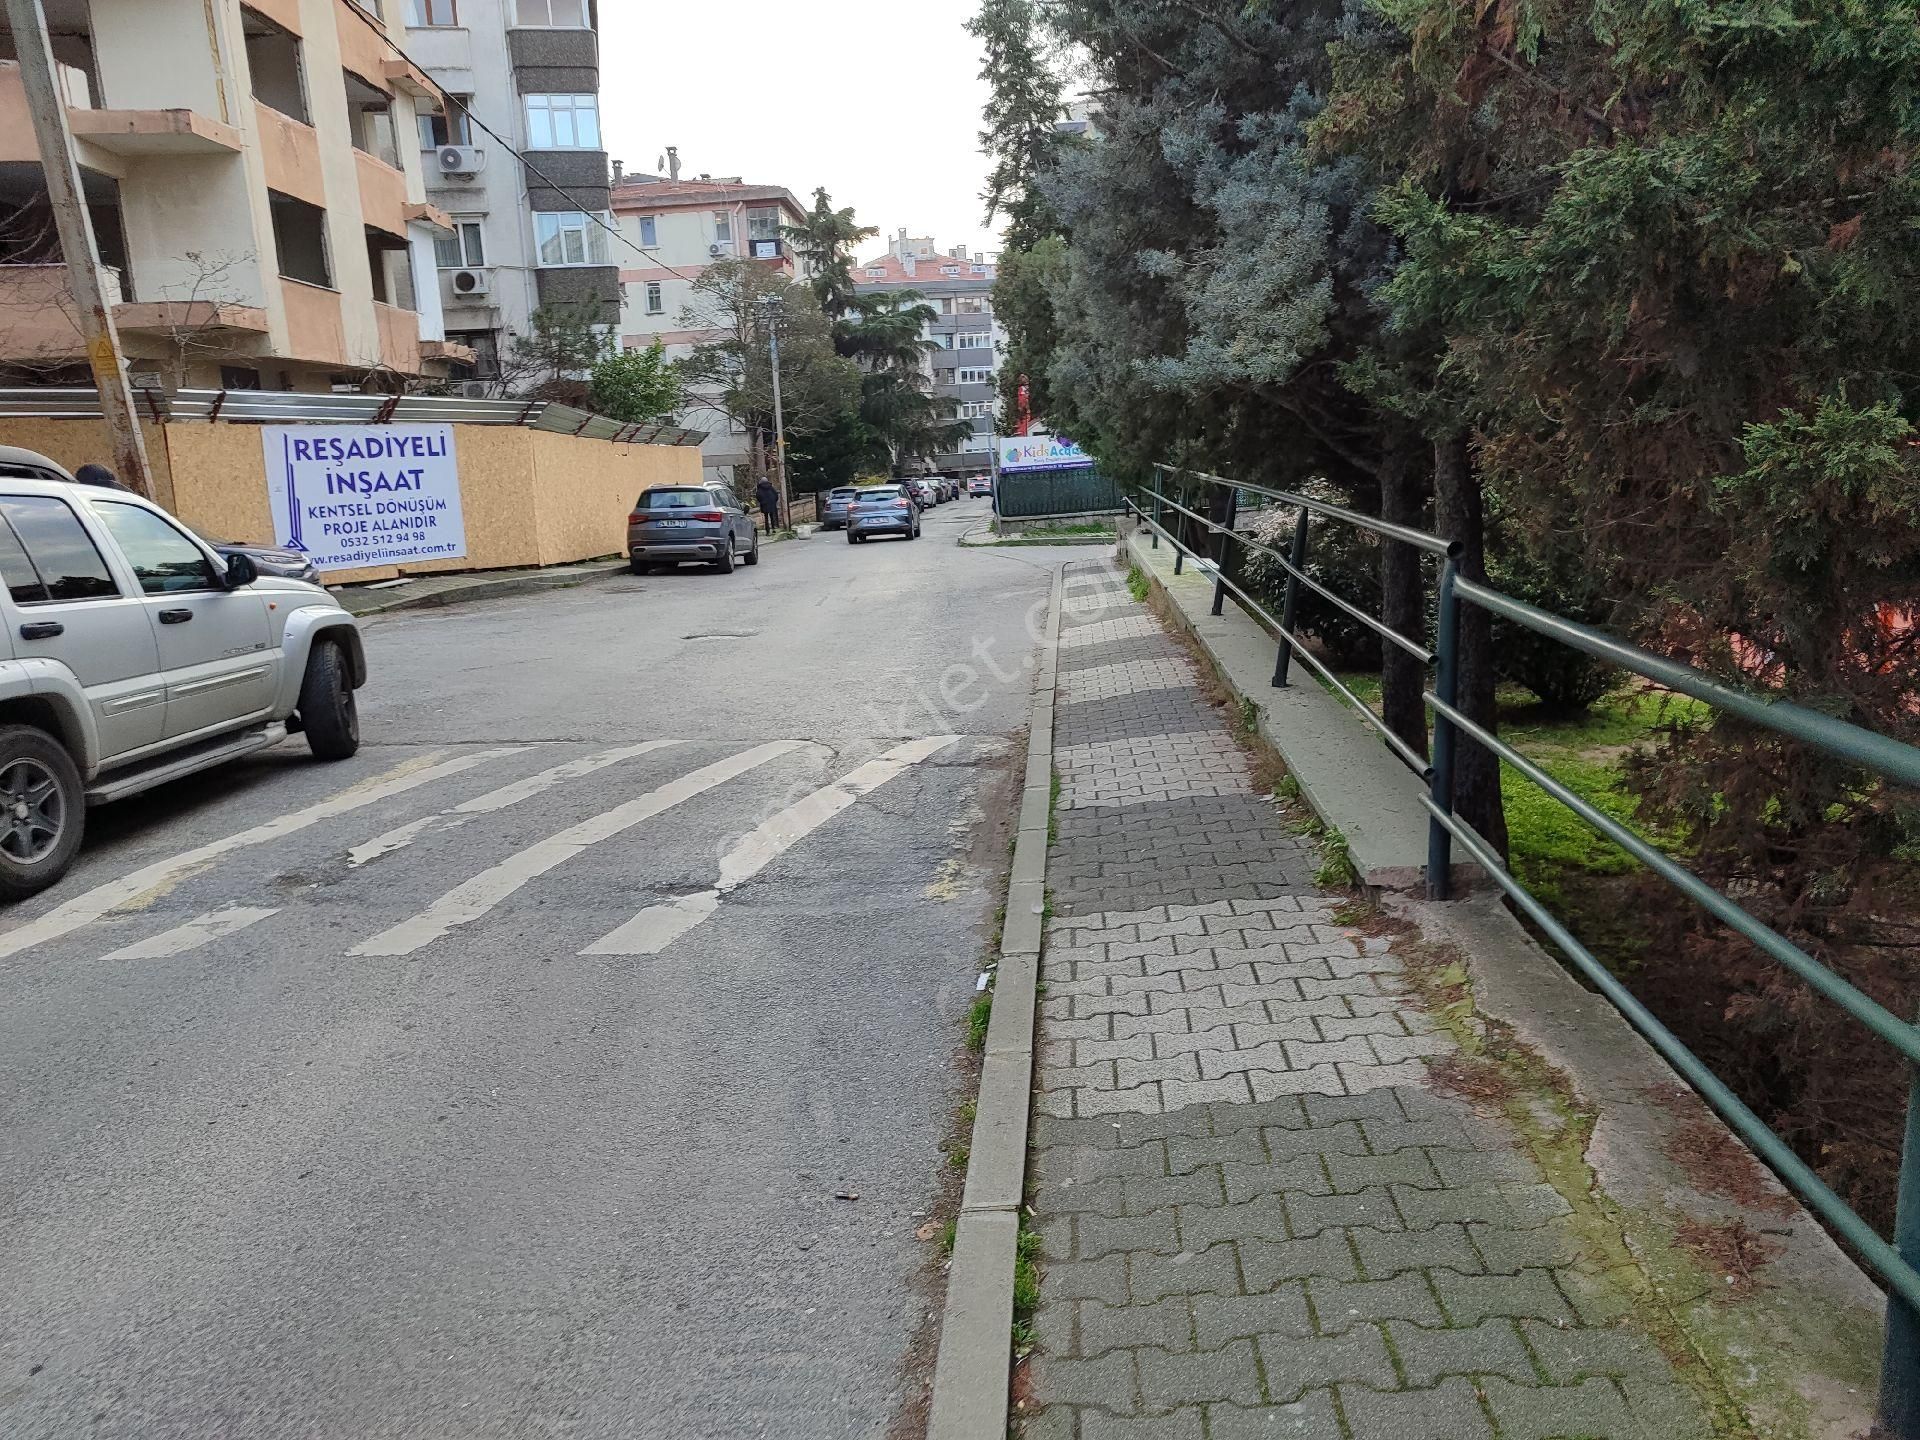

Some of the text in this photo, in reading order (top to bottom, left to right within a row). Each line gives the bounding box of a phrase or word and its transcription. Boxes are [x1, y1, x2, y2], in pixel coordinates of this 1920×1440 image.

[293, 430, 447, 467] REŞADİYELİ
[326, 467, 424, 500] İNŞAAT
[308, 495, 447, 519] KENTSEL DÖNÜŞÜM
[323, 515, 437, 536] PROJE ALANIDIR
[340, 531, 426, 548] 0532 512 94 98
